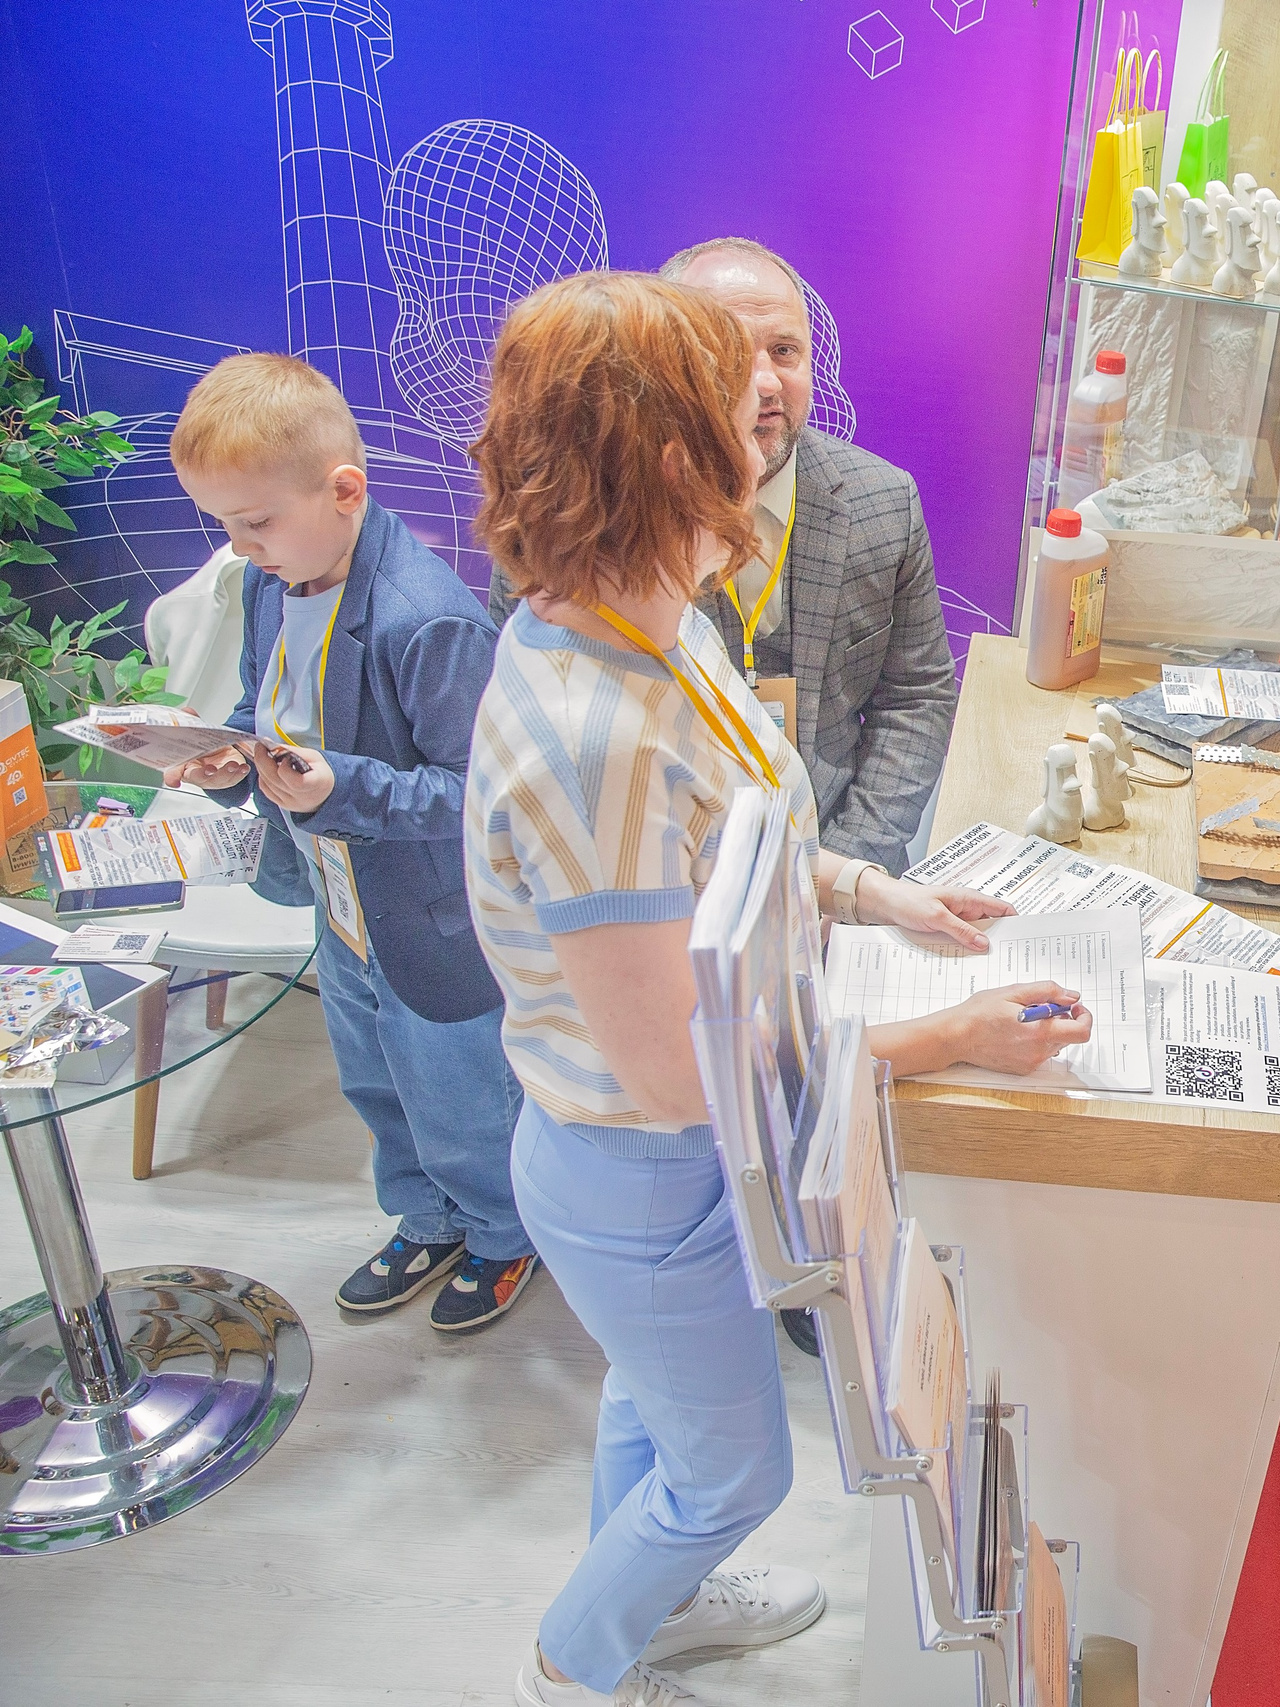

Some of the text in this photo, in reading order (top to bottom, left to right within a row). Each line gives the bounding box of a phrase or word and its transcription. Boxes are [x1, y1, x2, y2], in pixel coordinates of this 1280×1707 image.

[213, 819, 236, 860] PRODUCT QUALITY
[223, 815, 248, 860] MOLDS THAT DEFINE
[909, 822, 988, 877] EQUIPMENT THAT WORKS
[932, 857, 953, 871] REAL
[949, 829, 991, 860] PRODUCTION
[999, 878, 1017, 893] THIS
[1013, 862, 1037, 881] MODEL
[1033, 846, 1057, 865] WORKS
[1128, 883, 1152, 901] DEFINE
